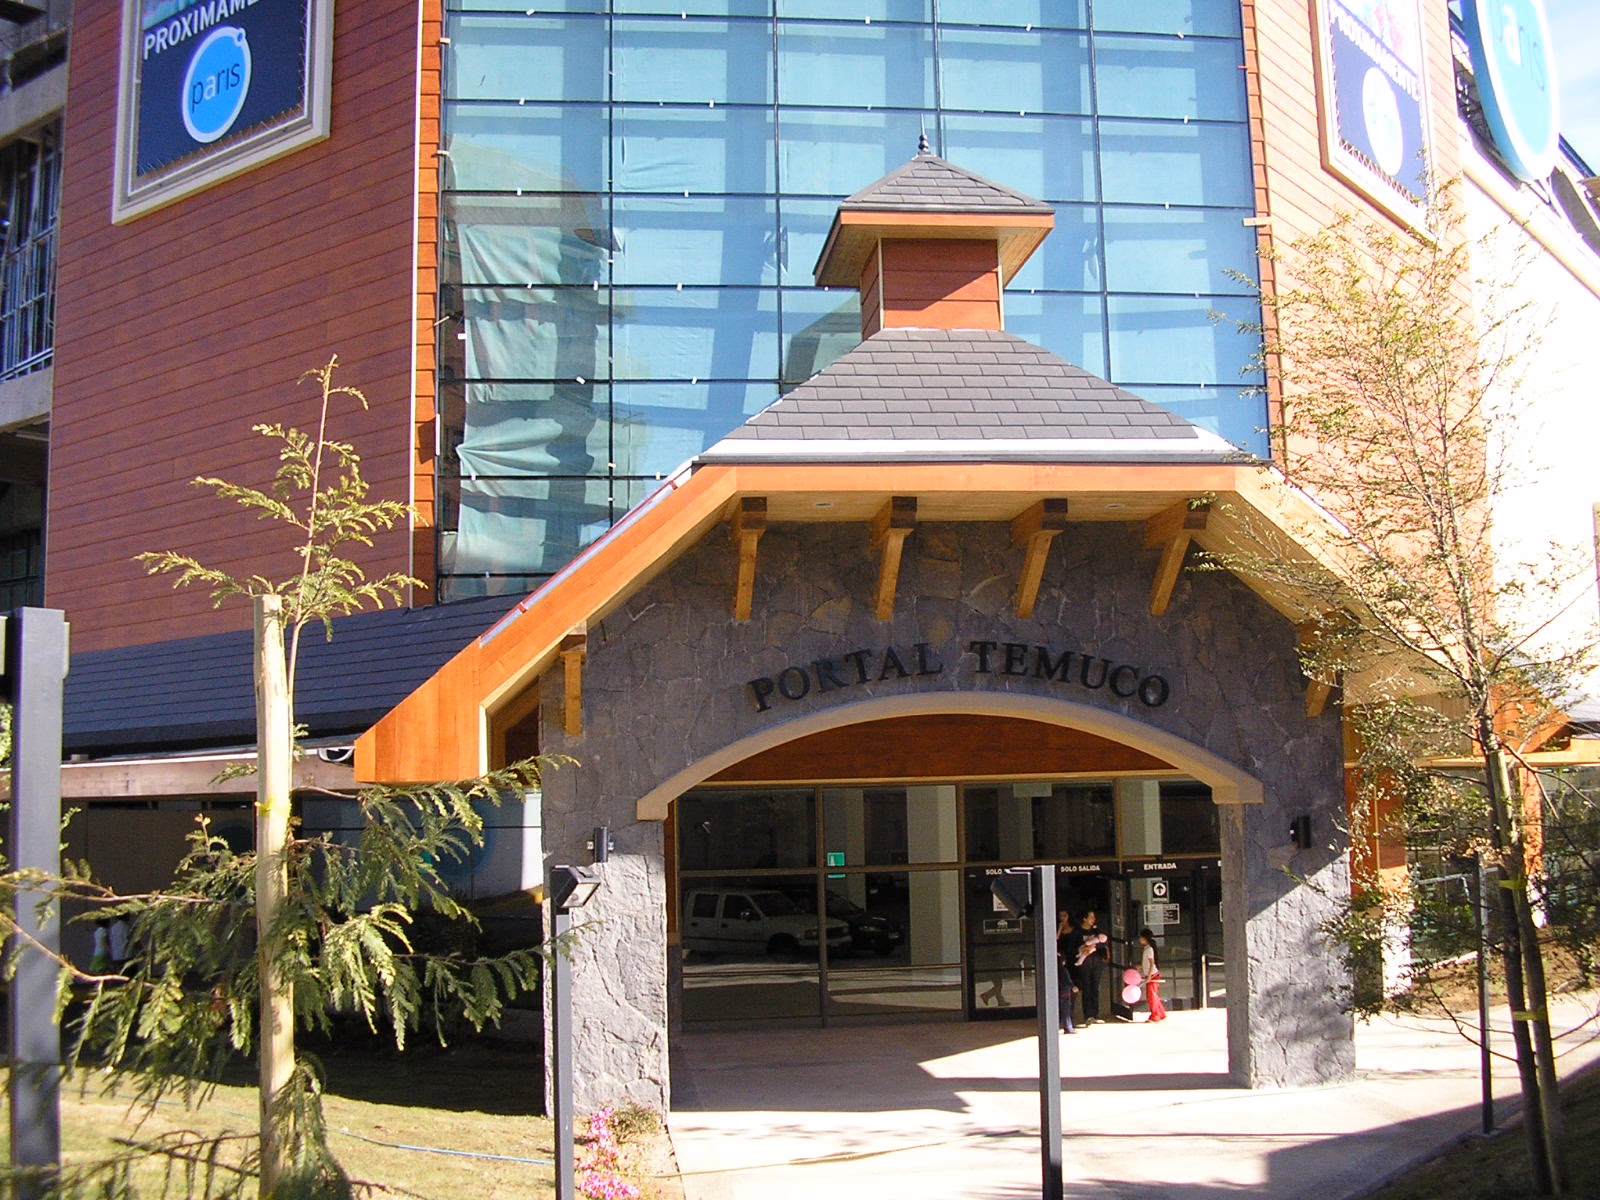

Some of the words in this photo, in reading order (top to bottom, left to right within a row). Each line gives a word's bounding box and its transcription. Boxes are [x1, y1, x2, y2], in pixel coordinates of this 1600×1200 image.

[143, 0, 259, 60] PROXIMAM
[191, 62, 241, 113] paris
[747, 642, 944, 713] PORTAL
[969, 641, 1170, 708] TEMUCO
[985, 868, 1003, 876] SOLO
[1143, 862, 1177, 871] ENTRADA
